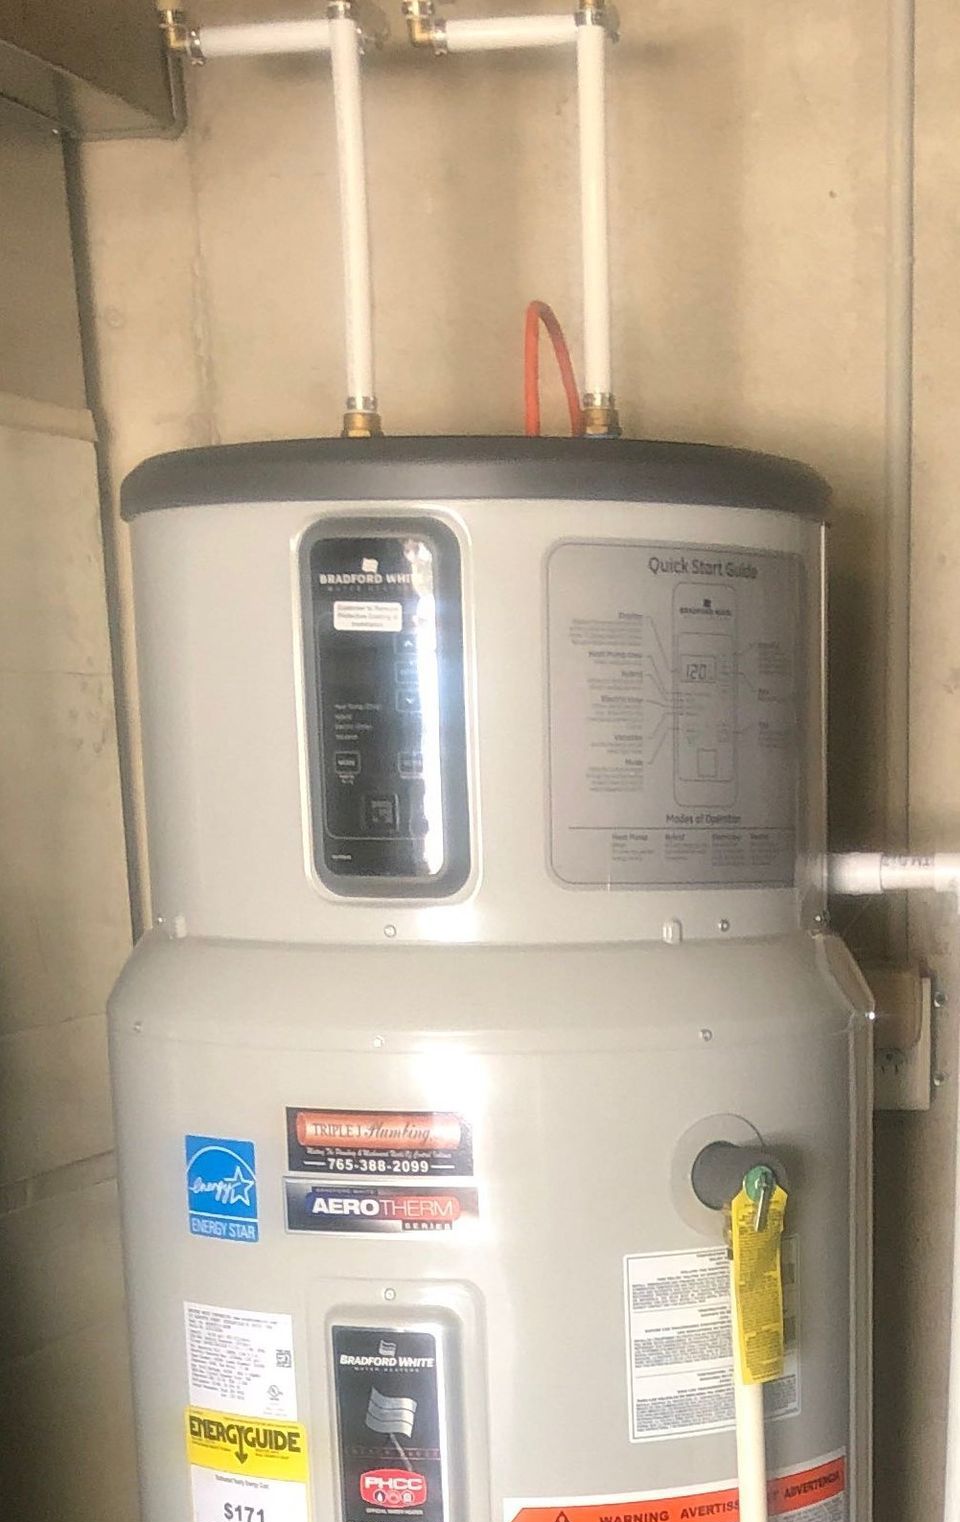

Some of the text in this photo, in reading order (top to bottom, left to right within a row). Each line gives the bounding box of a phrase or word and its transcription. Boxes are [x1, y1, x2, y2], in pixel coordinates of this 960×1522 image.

[648, 556, 759, 580] Quick Start Guide
[319, 573, 383, 584] BRADFORD
[312, 1122, 354, 1138] TRIPLE
[327, 1158, 429, 1173] 765-388-2099
[312, 1197, 453, 1217] AEROTHERM
[191, 1217, 256, 1240] ENERGY STAR
[340, 1354, 435, 1367] BRADFORD WHITE
[364, 1476, 423, 1491] PHCC
